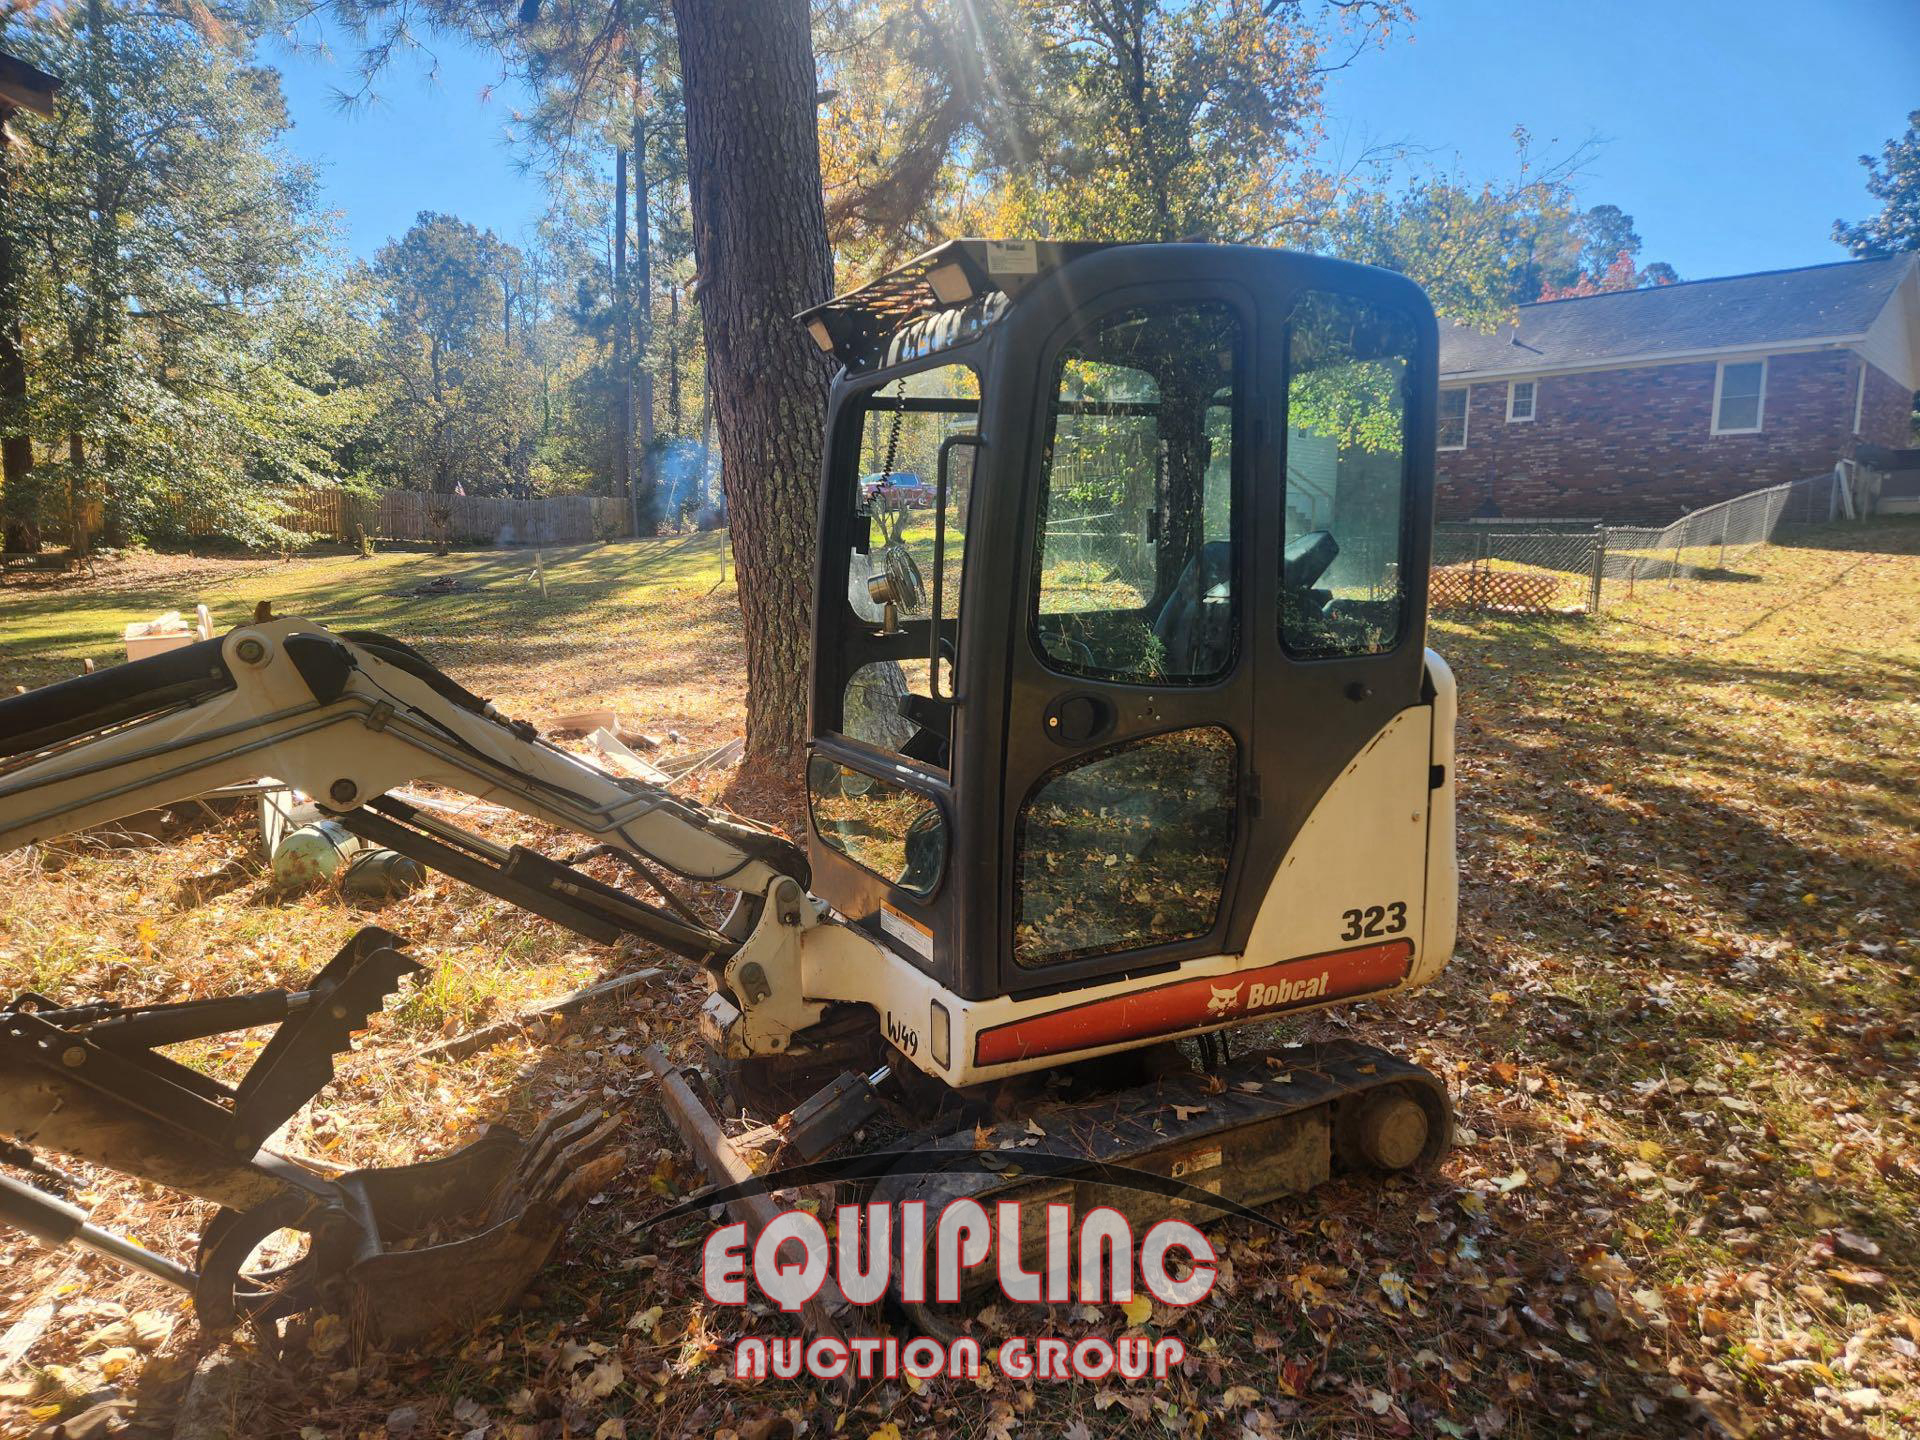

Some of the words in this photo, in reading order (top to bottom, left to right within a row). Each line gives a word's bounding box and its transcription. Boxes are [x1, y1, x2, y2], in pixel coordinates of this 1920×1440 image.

[1341, 901, 1407, 941] 323
[1246, 971, 1329, 1009] Bobcat
[887, 1011, 918, 1057] W49
